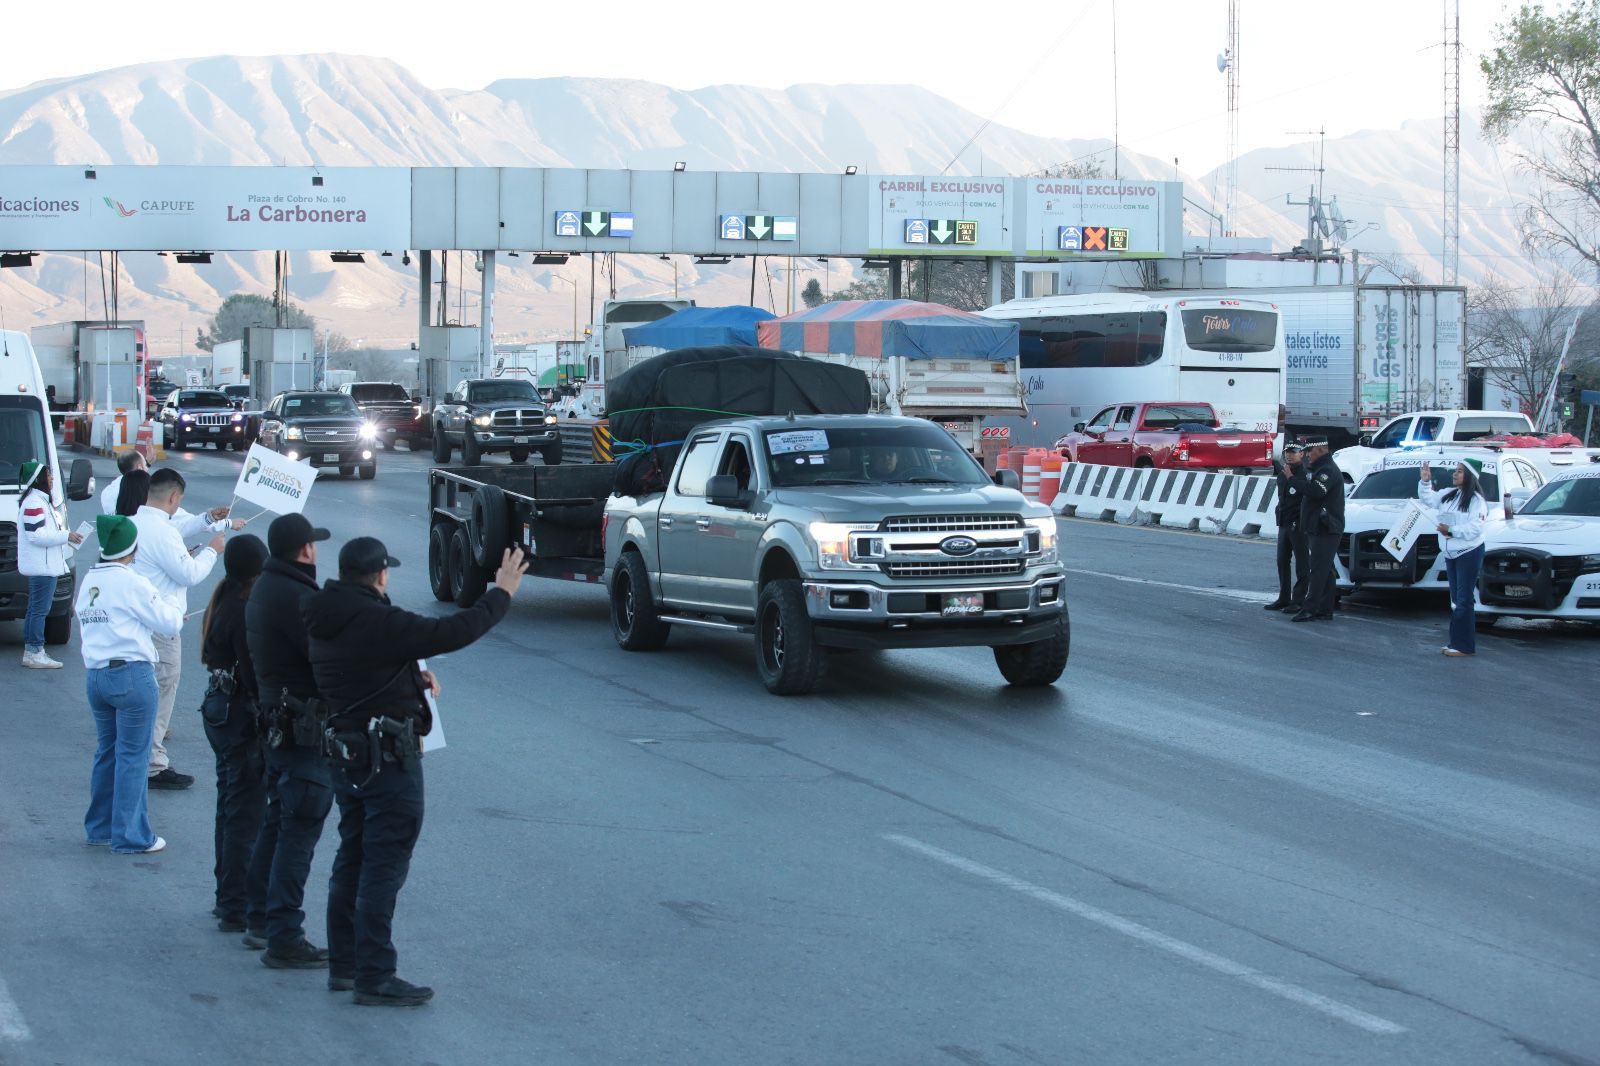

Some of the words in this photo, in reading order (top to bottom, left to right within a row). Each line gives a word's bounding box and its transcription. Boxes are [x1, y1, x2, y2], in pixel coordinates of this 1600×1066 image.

[879, 181, 927, 192] CARRIL
[930, 182, 1004, 194] EXCLUSIVO
[1036, 183, 1083, 195] CARRIL
[1086, 185, 1156, 197] EXCLUSIVO
[141, 200, 195, 211] CAPUFE
[248, 195, 271, 203] Plaza
[273, 195, 284, 203] de
[287, 195, 313, 203] Cobro
[333, 196, 346, 204] 140
[227, 205, 251, 222] La
[258, 204, 366, 223] Carbonera
[1202, 315, 1231, 335] Tours
[1313, 330, 1341, 349] listos
[1287, 349, 1328, 369] servirse
[1254, 422, 1273, 432] 2033
[257, 475, 302, 499] paisanos
[943, 606, 983, 614] HIDALGO
